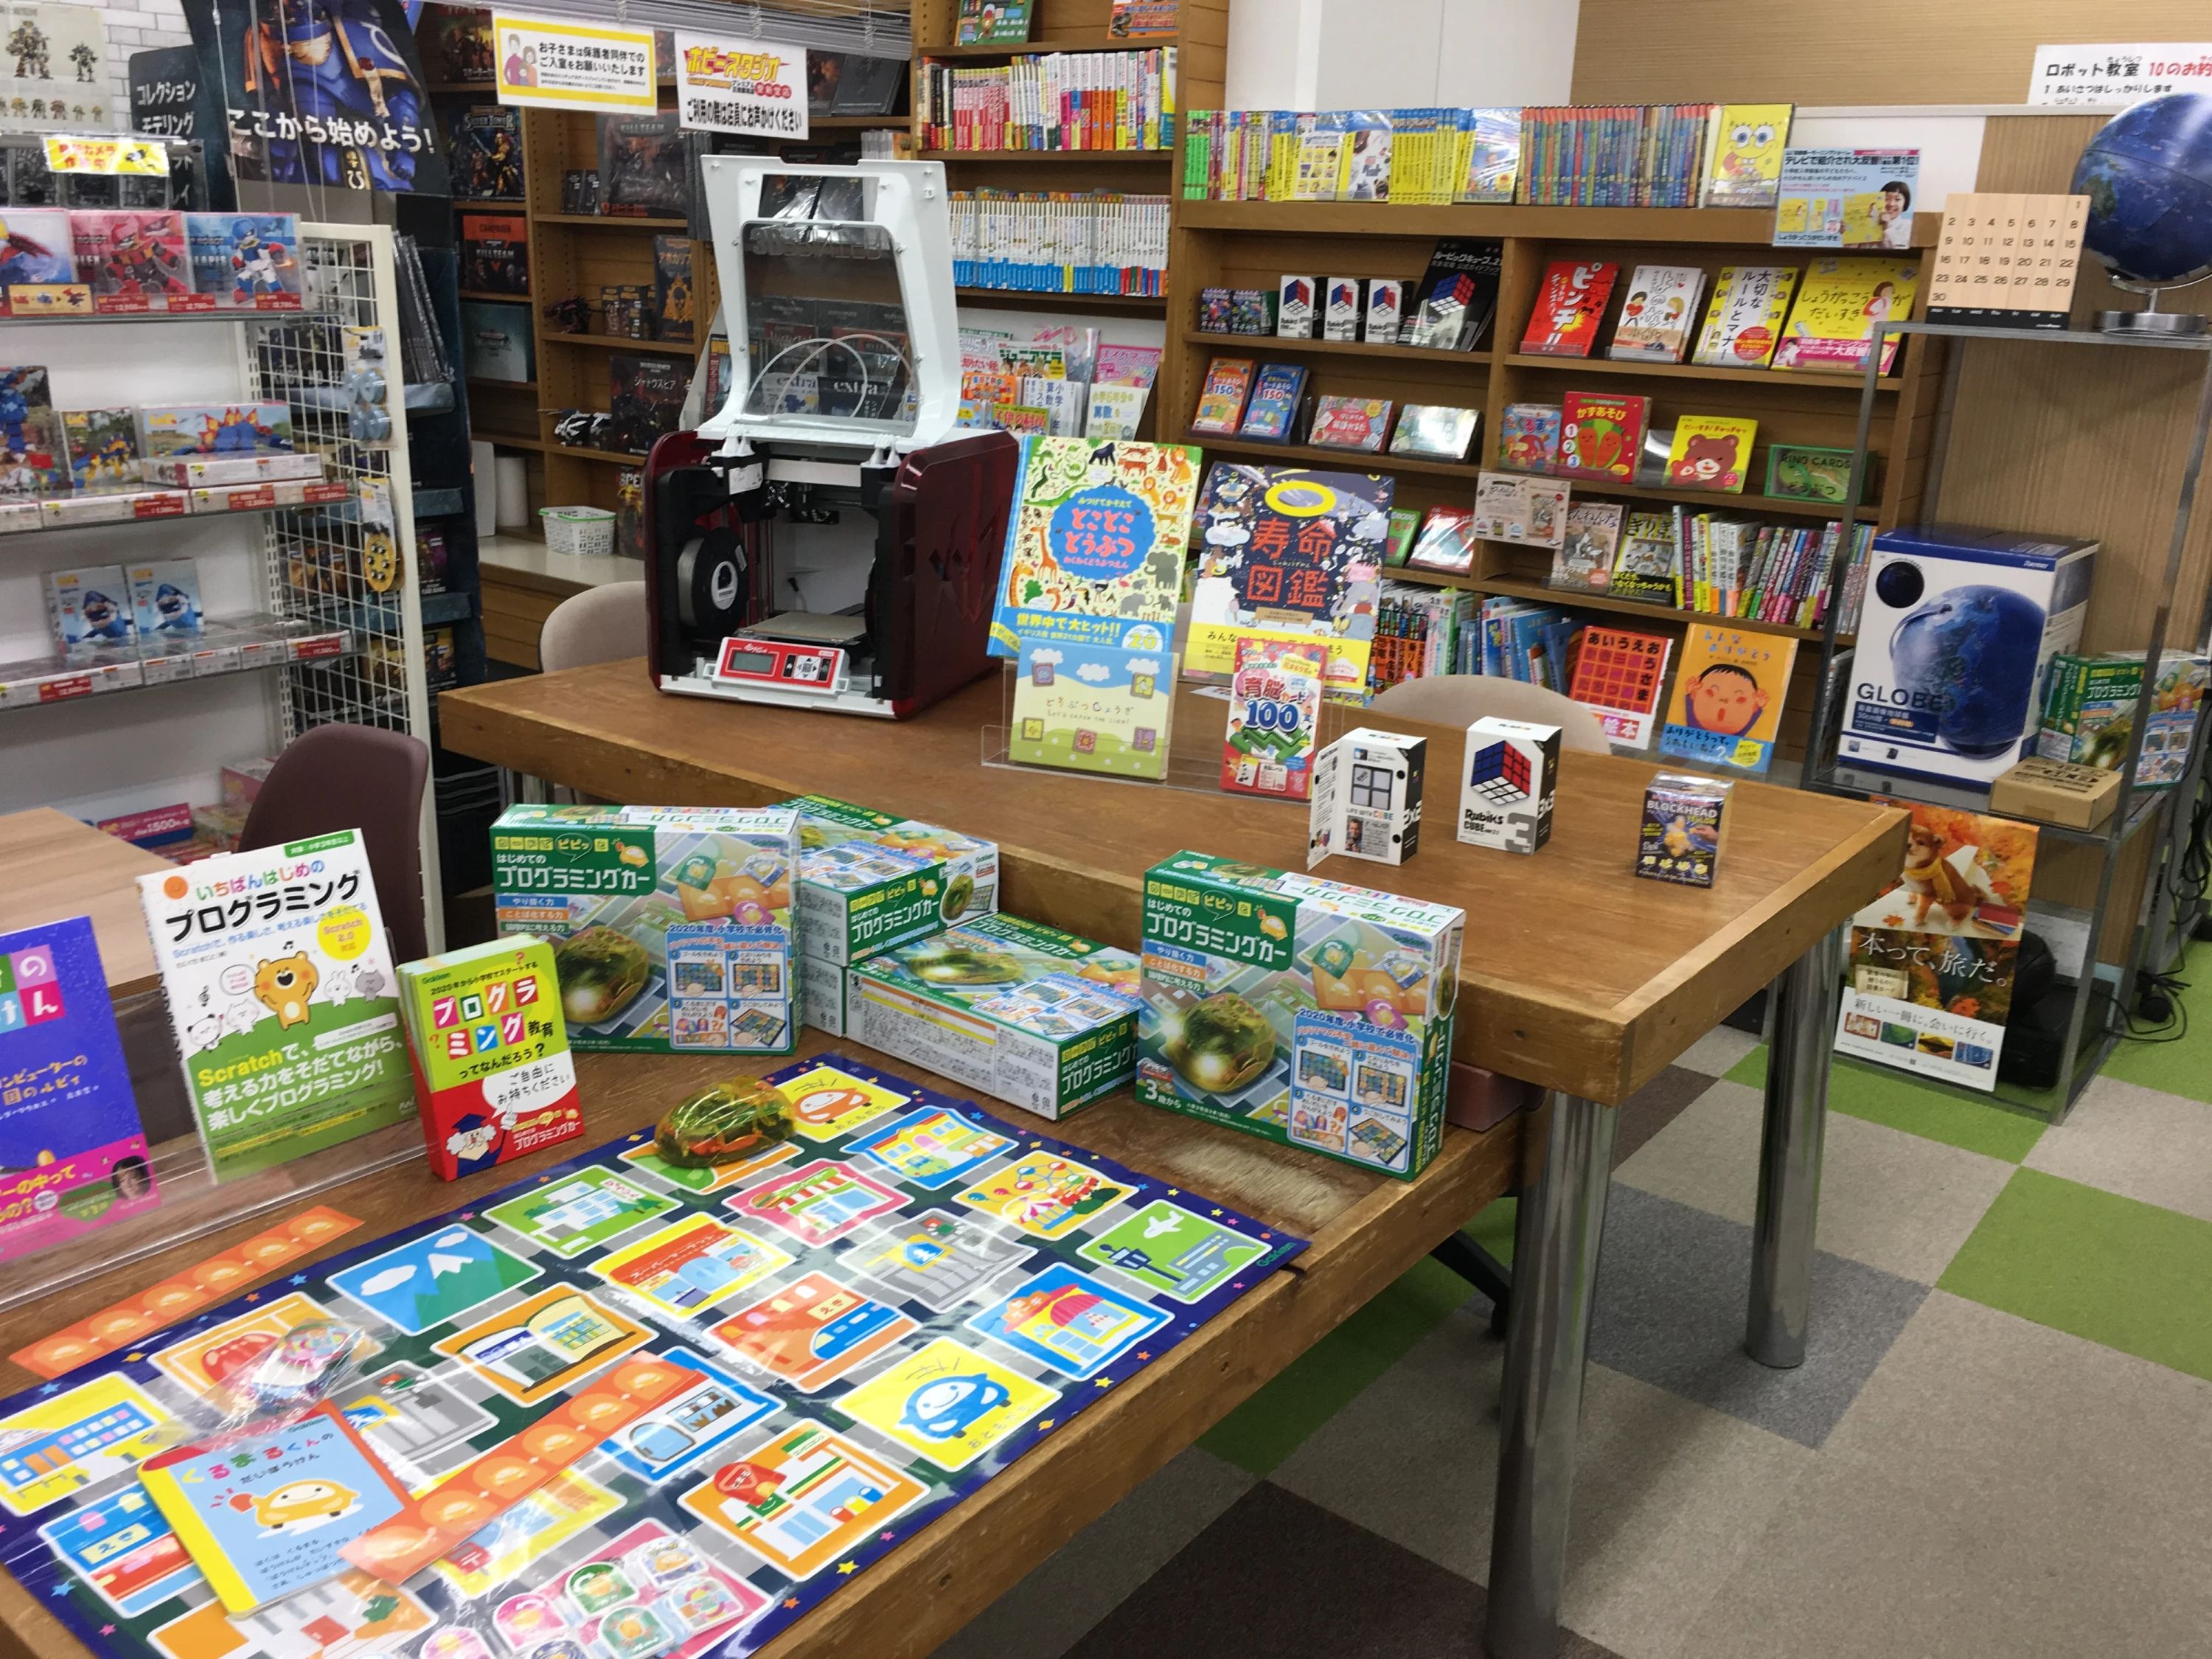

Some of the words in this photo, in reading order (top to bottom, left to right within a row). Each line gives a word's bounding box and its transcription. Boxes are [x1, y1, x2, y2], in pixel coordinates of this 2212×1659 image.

[540, 56, 645, 77] ご入室をお願いいたします
[2046, 63, 2140, 77] ロボット教室
[136, 80, 196, 106] コレクション
[2057, 83, 2173, 94] あいさつはしっかりします
[1947, 218, 1956, 226] 2
[1967, 218, 1976, 226] 3
[1987, 218, 1996, 226] 4
[2008, 219, 2015, 227] 5
[2028, 219, 2036, 228] 6
[2048, 220, 2056, 228] 7
[2070, 220, 2078, 229] 8
[1944, 237, 1952, 245] 9
[1963, 237, 1974, 246] 10
[1984, 237, 1993, 246] 11
[2003, 237, 2013, 246] 12
[2023, 238, 2034, 247] 13
[2043, 239, 2054, 248] 14
[2065, 239, 2076, 248] 15
[1941, 255, 1951, 265] 16
[1959, 256, 1970, 265] 17
[1979, 256, 1990, 265] 18
[1999, 257, 2010, 265] 19
[2017, 257, 2032, 266] 20
[2039, 258, 2051, 267] 21
[2059, 259, 2074, 268] 22
[1750, 271, 1773, 310] 大切な
[1935, 274, 1949, 283] 23
[1955, 274, 1967, 284] 24
[1975, 275, 1988, 284] 25
[1994, 276, 2008, 285] 26
[2014, 276, 2028, 285] 27
[2034, 276, 2049, 286] 28
[2055, 278, 2070, 288] 29
[1801, 290, 1871, 305] しょうがっこう
[1891, 293, 1912, 307] が
[1932, 292, 1947, 301] 30
[1720, 271, 1755, 361] ルールとマナー
[1809, 307, 1861, 322] だいすき
[832, 379, 879, 395] extra
[1213, 385, 1234, 396] 150
[1262, 389, 1285, 400] 150
[1568, 425, 1575, 437] 1
[1565, 442, 1573, 452] 2
[1781, 453, 1809, 466] RING
[1811, 456, 1852, 469] CARDS
[1071, 507, 1135, 534] どこどこ
[1065, 531, 1135, 557] どうぶつ
[1249, 516, 1338, 564] 寿命
[1245, 562, 1330, 608] 図鑑
[1016, 613, 1121, 638] 世界中で大ヒット!!
[1206, 630, 1237, 644] みんな
[1127, 633, 1158, 650] 20
[1587, 632, 1661, 655] あいうえお
[1638, 657, 1658, 702] うさま
[1046, 697, 1135, 716] どうぶつしょうぎ
[1857, 683, 1944, 712] GLOBE
[1093, 714, 1106, 723] THE
[1244, 699, 1301, 734] 100
[1602, 717, 1638, 740] 絵本
[1346, 807, 1358, 815] LIFE
[1373, 810, 1395, 821] CUBE
[1646, 800, 1718, 818] BLOCKHEAD
[1464, 821, 1485, 832] CUBE
[1505, 812, 1538, 856] 3
[557, 837, 591, 851] ピピッ
[496, 853, 547, 865] はじめての
[195, 859, 326, 902] いちばんはじめの
[497, 866, 651, 891] プログラミングカー
[165, 869, 361, 943] プログラミング
[1147, 898, 1192, 918] はじめての
[1203, 894, 1234, 911] ピピッ
[851, 906, 880, 923] はじめての
[851, 899, 941, 944] プログラミングカー
[337, 931, 355, 943] 2.0
[970, 922, 1079, 957] プログラミングカー
[1146, 911, 1287, 963] プログラミングカー
[1858, 932, 2008, 987] 本って、旅だ。
[433, 976, 538, 1029] プログラ
[1854, 998, 1994, 1045] 新しい一冊に、会いに行く。
[198, 1042, 309, 1088] Scratchで、
[459, 1042, 546, 1079] ってなんだろう?
[1062, 1055, 1090, 1074] はじめての
[202, 1036, 404, 1109] 考える力をそだてながら、
[509, 1062, 554, 1086] ご自由に
[207, 1057, 386, 1133] 楽しくプログラミング!
[496, 1074, 570, 1105] お持ちください
[1144, 1079, 1182, 1109] 3歳から
[513, 1121, 582, 1152] プログラミングカー
[181, 1433, 334, 1484] くるまるくんの
[240, 1453, 321, 1486] だいぼうけん
